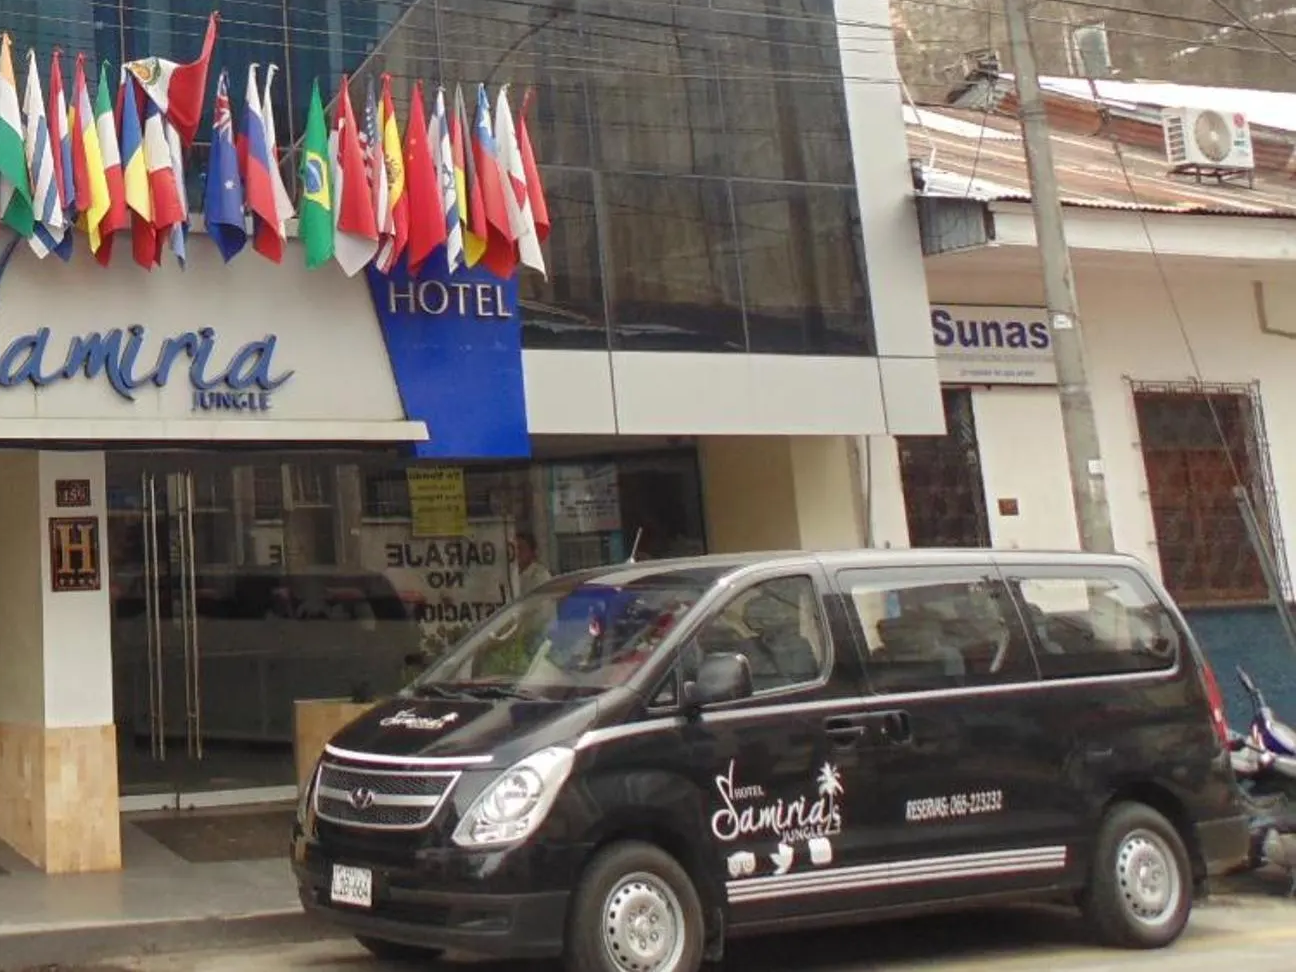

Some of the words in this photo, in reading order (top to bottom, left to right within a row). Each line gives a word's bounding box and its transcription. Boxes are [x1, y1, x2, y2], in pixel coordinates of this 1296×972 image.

[389, 280, 513, 317] HOTEL
[931, 309, 1050, 349] Sunas
[192, 391, 272, 410] JUNGLE
[711, 759, 828, 841] Samiria
[734, 785, 764, 799] HOTEL
